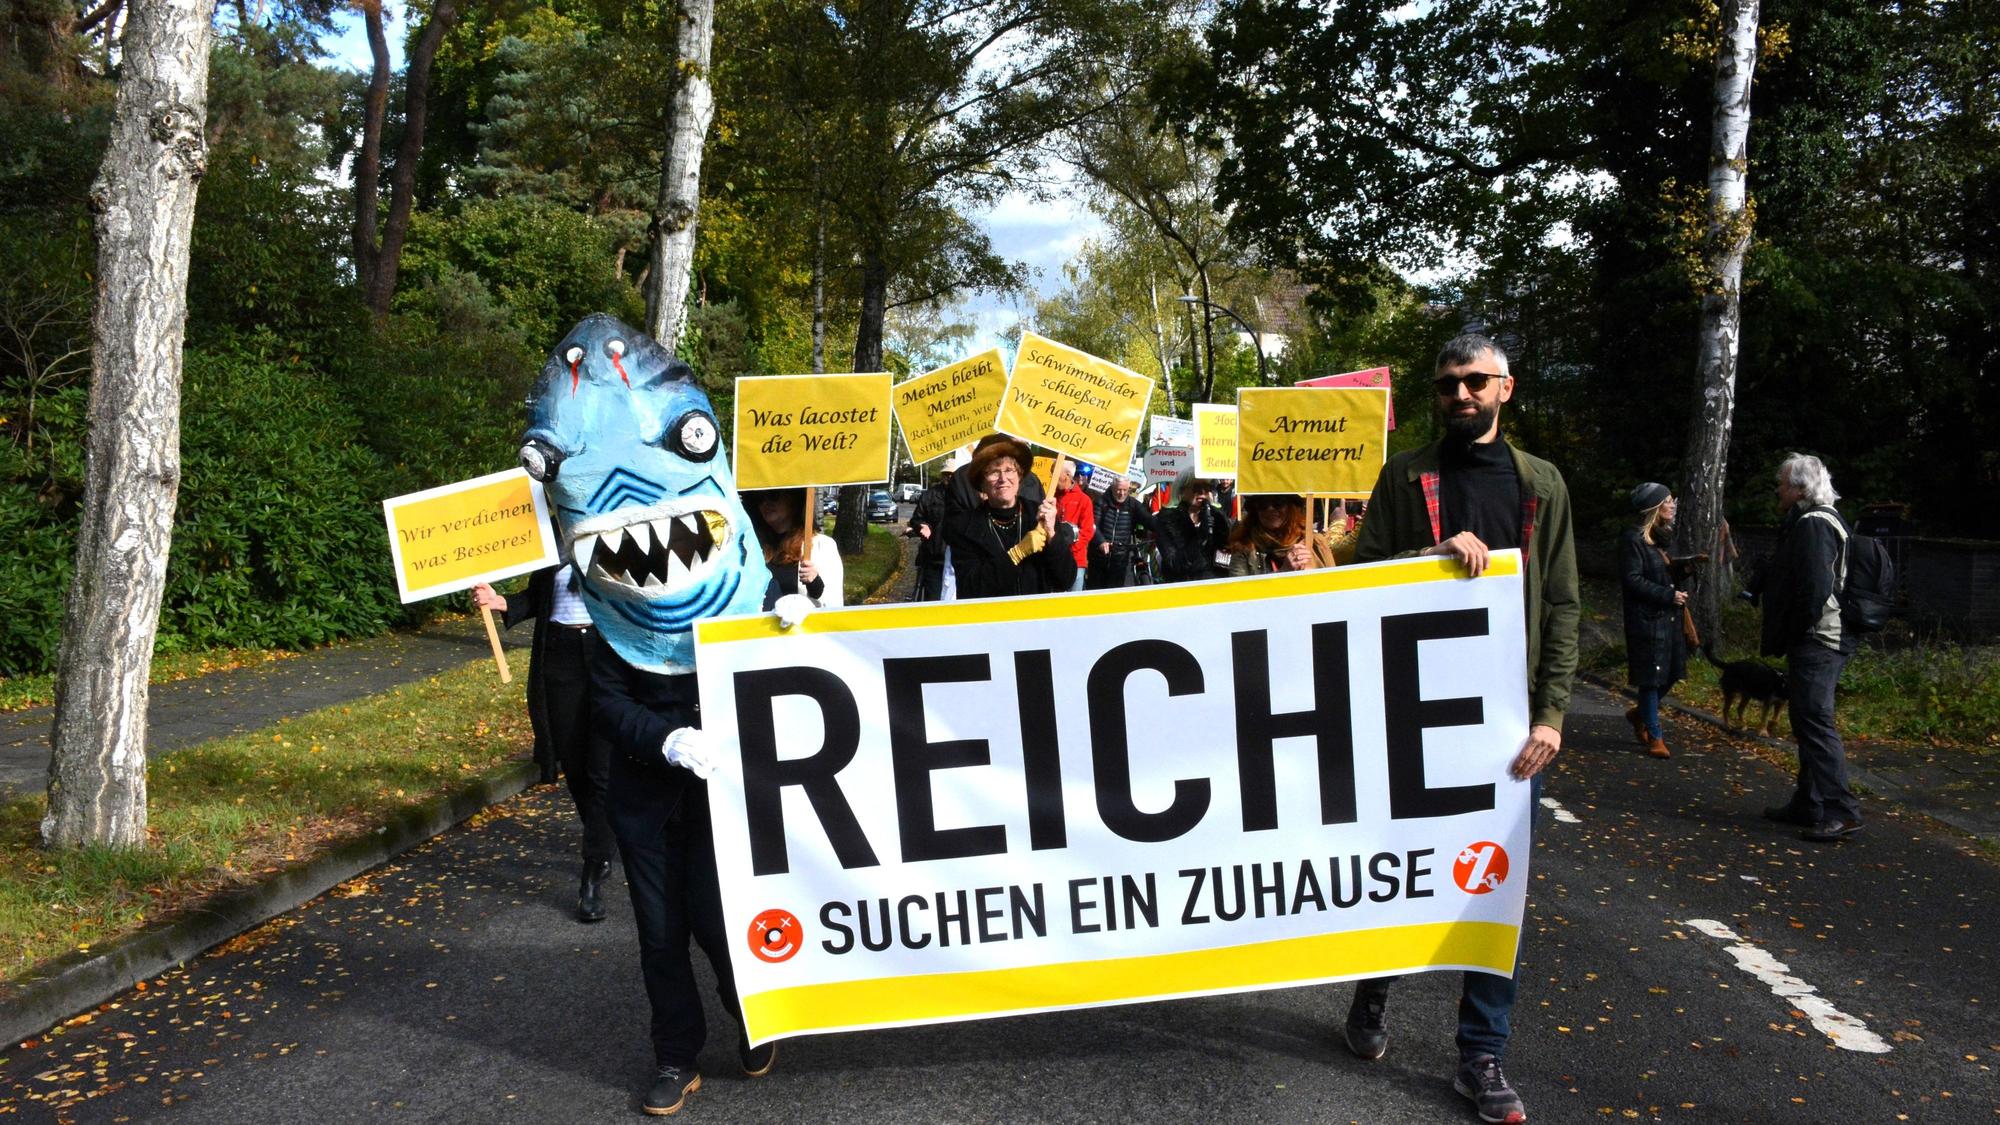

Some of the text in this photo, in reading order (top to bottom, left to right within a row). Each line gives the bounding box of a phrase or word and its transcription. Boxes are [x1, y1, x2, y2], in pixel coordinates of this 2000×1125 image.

[902, 361, 993, 406] Meins bleibt
[1027, 350, 1138, 400] Schwimmbäder
[928, 387, 976, 417] Meins!
[1041, 377, 1112, 410] schließen!
[747, 406, 878, 427] Was lacostet
[910, 413, 970, 440] Reichtum,
[973, 402, 993, 416] wie
[1012, 386, 1132, 444] Wir haben doch
[1214, 414, 1237, 426] Hoc
[1269, 416, 1347, 433] Armut
[761, 431, 857, 453] die Welt?
[920, 437, 948, 455] singt
[951, 424, 975, 442] und
[1041, 423, 1087, 449] Pools!
[1252, 442, 1364, 461] besteuern!
[400, 502, 534, 543] Wir verdienen
[411, 529, 532, 571] was Besseres!
[733, 607, 1496, 876] REICHE
[819, 848, 1435, 956] SUCHEN EIN ZUHAUSE
